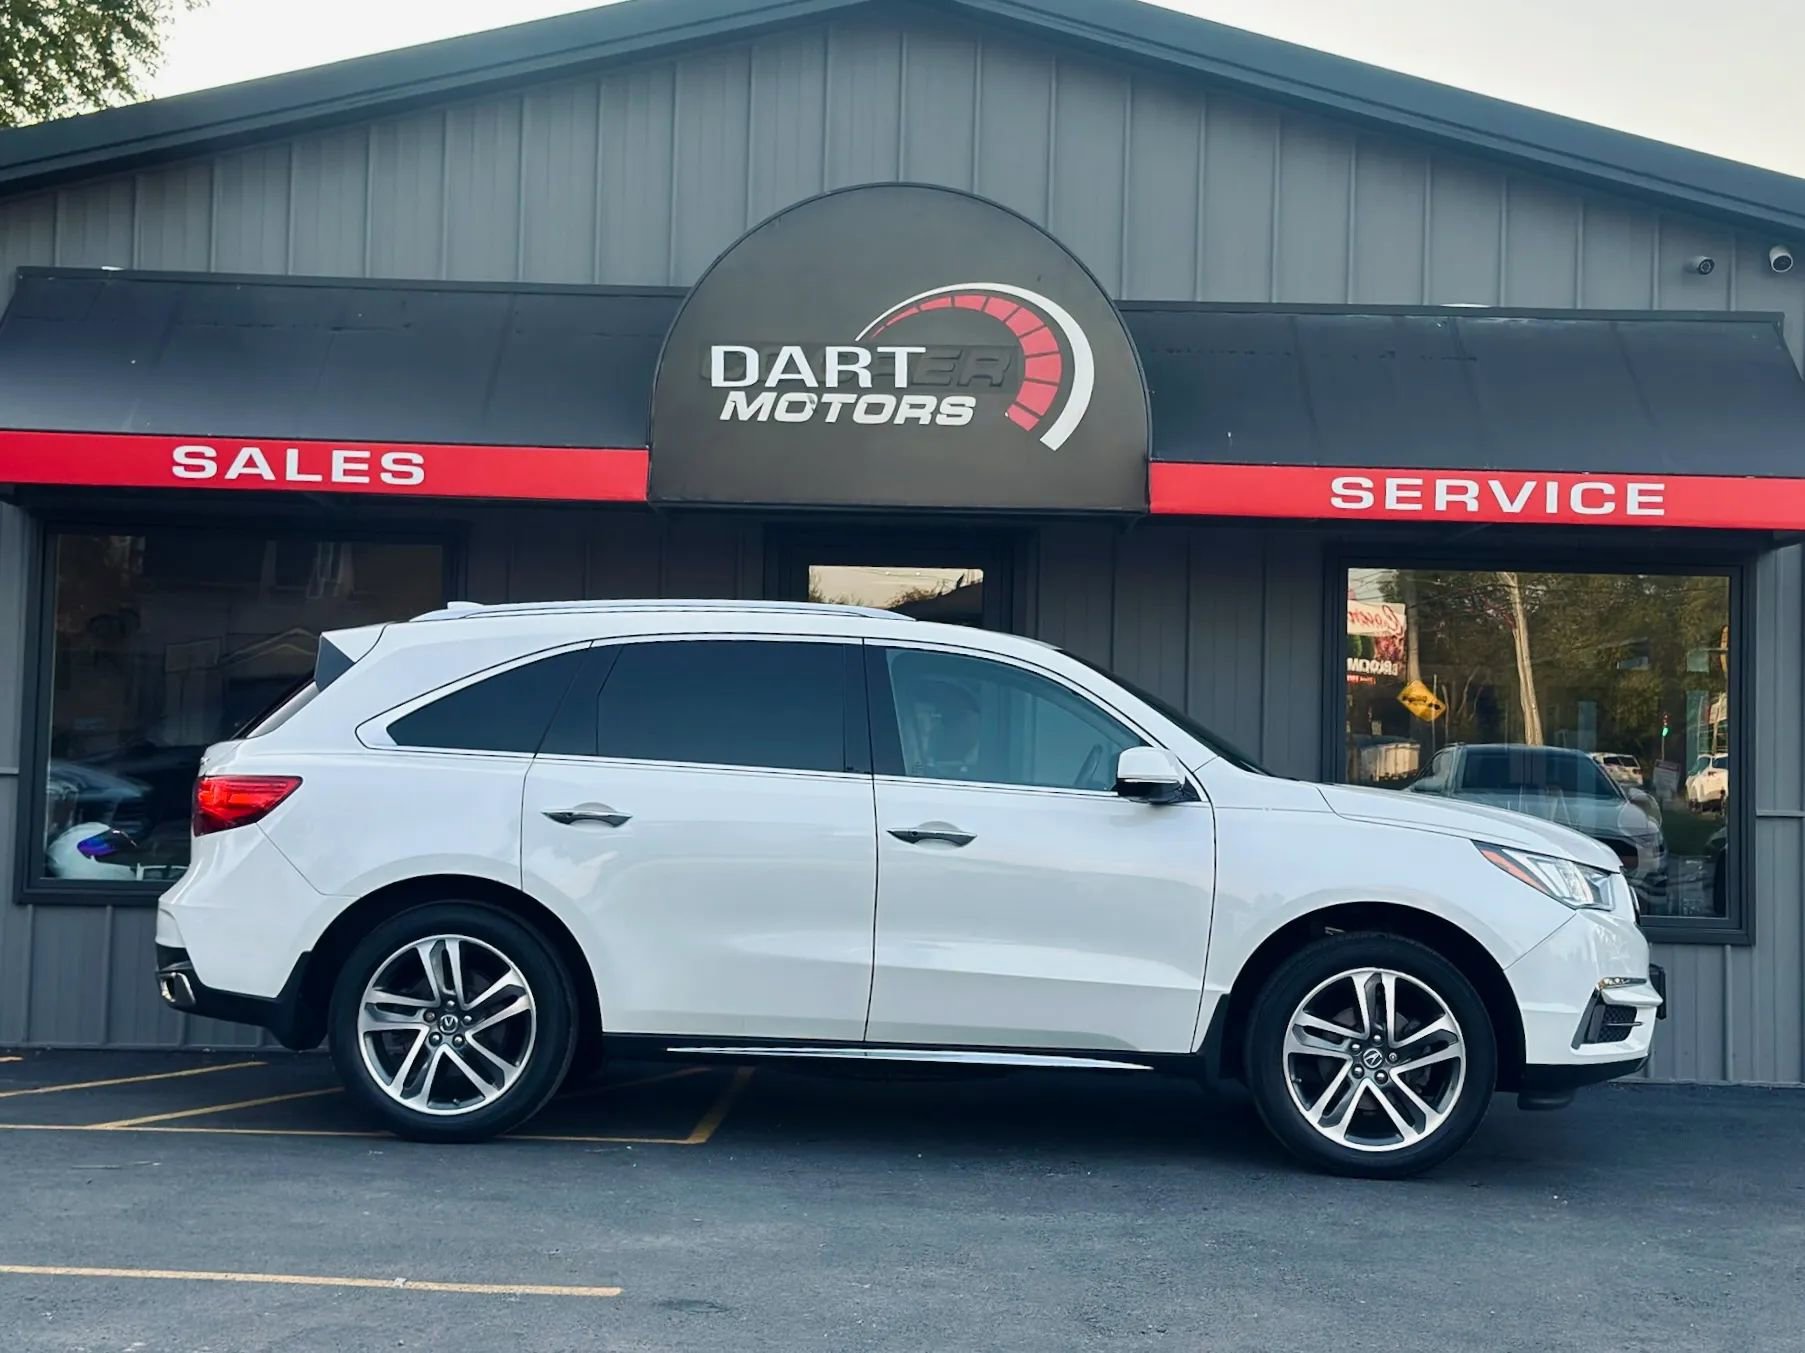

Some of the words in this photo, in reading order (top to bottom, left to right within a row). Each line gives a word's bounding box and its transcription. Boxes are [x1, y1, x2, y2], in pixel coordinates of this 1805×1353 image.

[711, 345, 926, 388] DART
[720, 391, 977, 425] MOTORS
[172, 445, 425, 486] SALES
[1330, 476, 1666, 516] SERVICE
